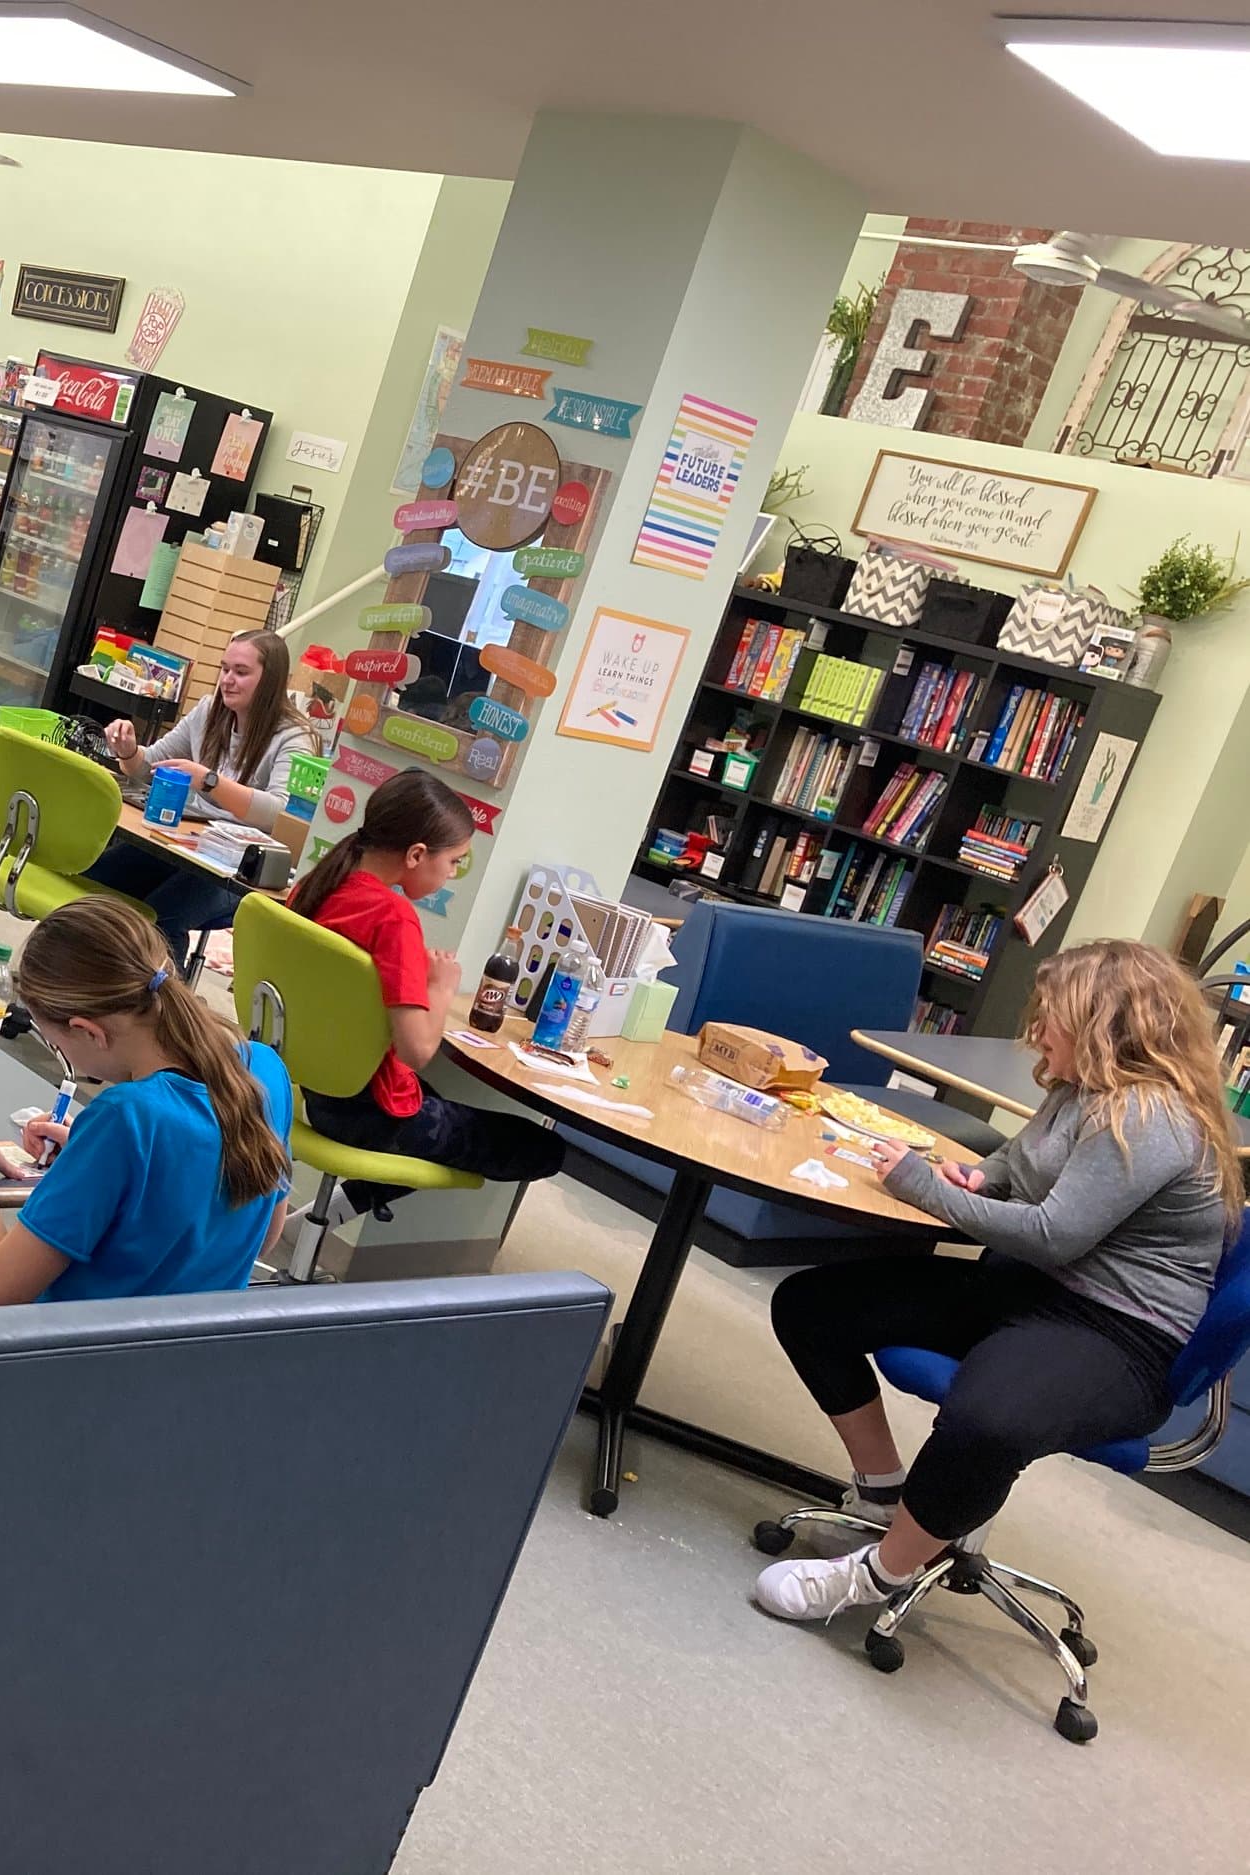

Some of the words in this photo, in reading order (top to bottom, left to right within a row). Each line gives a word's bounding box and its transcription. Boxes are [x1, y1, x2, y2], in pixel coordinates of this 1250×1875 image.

[24, 281, 110, 312] CONCESSIONS
[141, 323, 161, 341] CORN
[148, 315, 164, 331] POP
[471, 363, 541, 391] REMARKABLE
[557, 396, 628, 430] RESPONSIBLE
[291, 440, 336, 464] Jesus
[680, 453, 726, 479] FUTURE
[460, 455, 556, 514] #BE
[676, 467, 720, 492] LEADERS
[908, 464, 935, 486] You
[936, 471, 963, 491] will
[960, 476, 979, 496] be
[979, 479, 1035, 508] blessed
[397, 508, 453, 523] Trustworthy
[554, 495, 586, 517] exciting
[906, 485, 939, 507] when
[939, 497, 965, 512] you
[965, 504, 997, 520] come
[999, 508, 1014, 521] in
[1014, 509, 1052, 530] and
[887, 501, 938, 528] blessed
[933, 510, 965, 532] when
[966, 522, 995, 538] you
[993, 526, 1010, 544] go
[520, 553, 581, 572] patient
[506, 589, 564, 626] imaginative
[354, 655, 399, 679] inspired
[603, 651, 639, 671] WAKE
[643, 660, 660, 674] UP
[598, 667, 623, 679] LEARN
[625, 673, 654, 687] THINGS
[478, 702, 523, 739] HONEST
[390, 724, 450, 755] confident
[468, 748, 499, 770] Real
[326, 793, 353, 816] STRONG
[469, 807, 487, 824] ble
